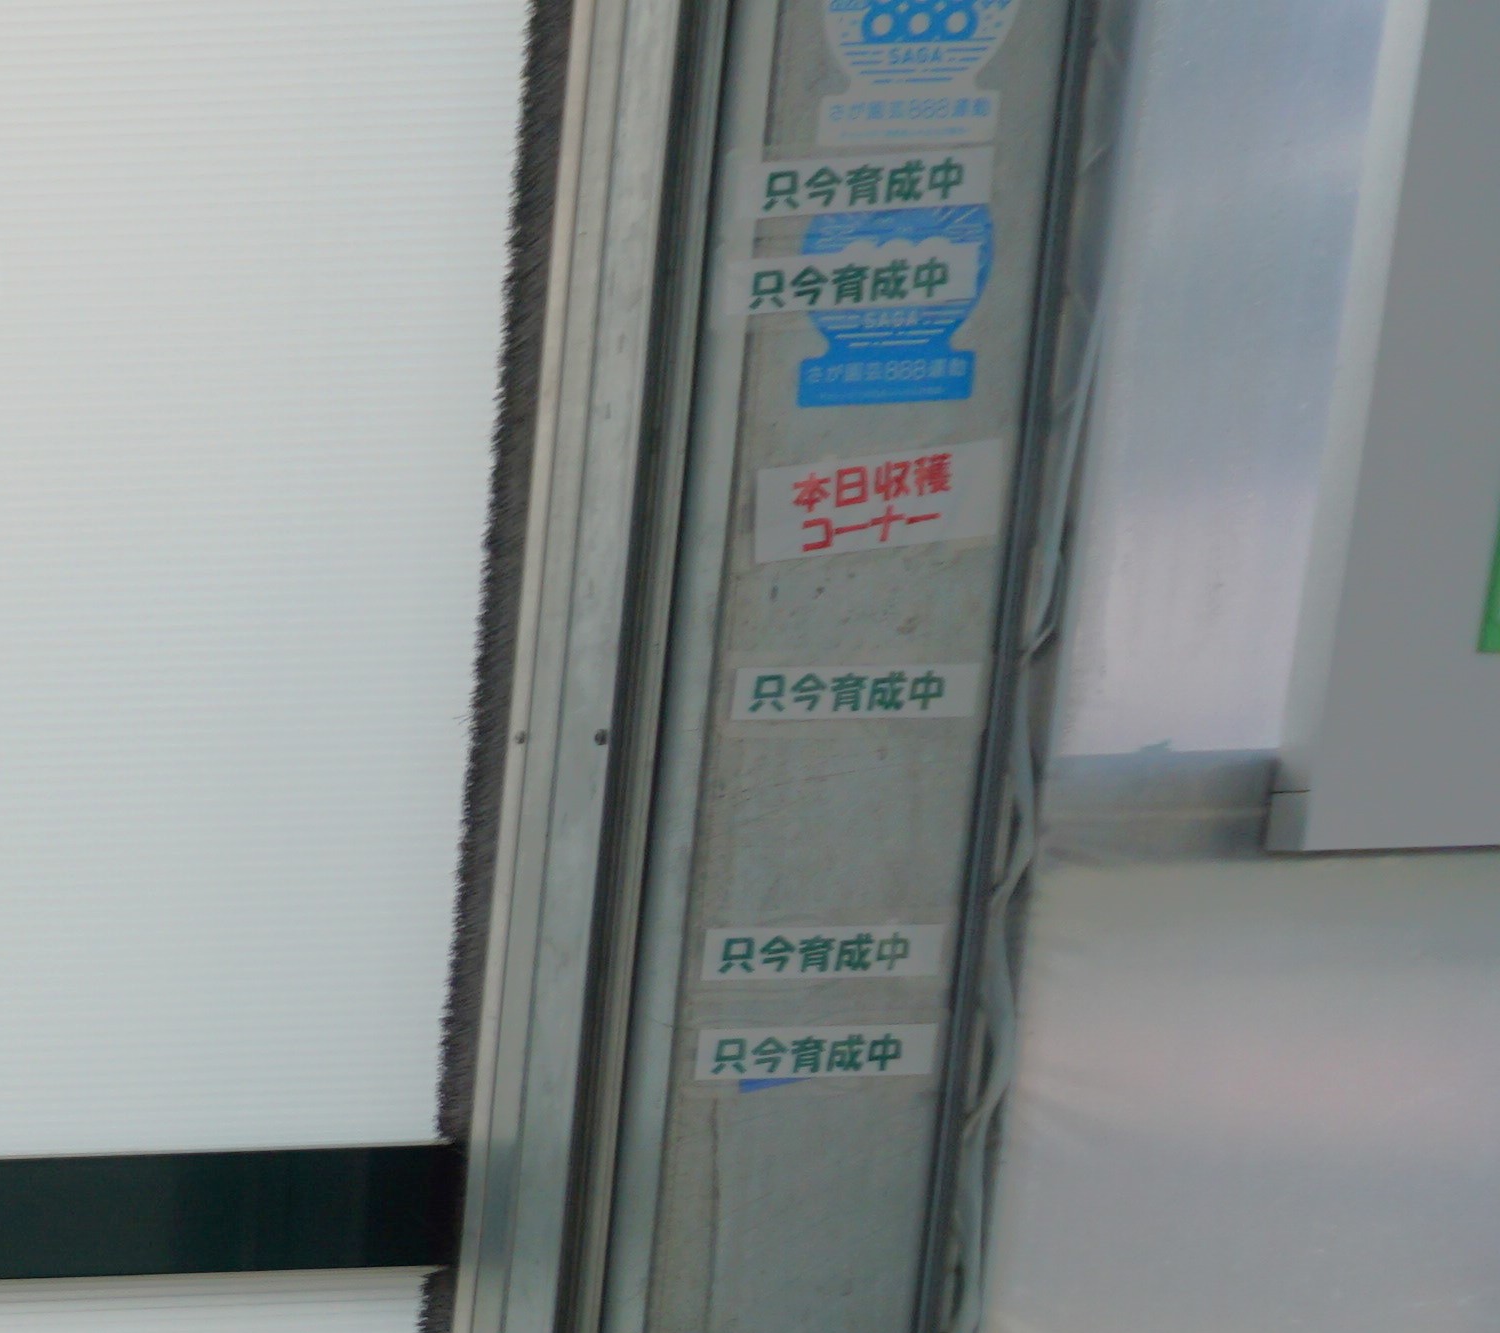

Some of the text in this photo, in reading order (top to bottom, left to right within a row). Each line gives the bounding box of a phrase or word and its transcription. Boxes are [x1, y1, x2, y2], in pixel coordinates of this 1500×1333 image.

[762, 157, 964, 212] 只今育成中
[749, 257, 950, 310] 只今育成中
[791, 452, 953, 513] 本日収穫
[801, 504, 942, 552] コーナー
[748, 669, 946, 713] 只今育成中
[718, 931, 911, 974] 只今育成中
[710, 1032, 902, 1076] 只今育成中
